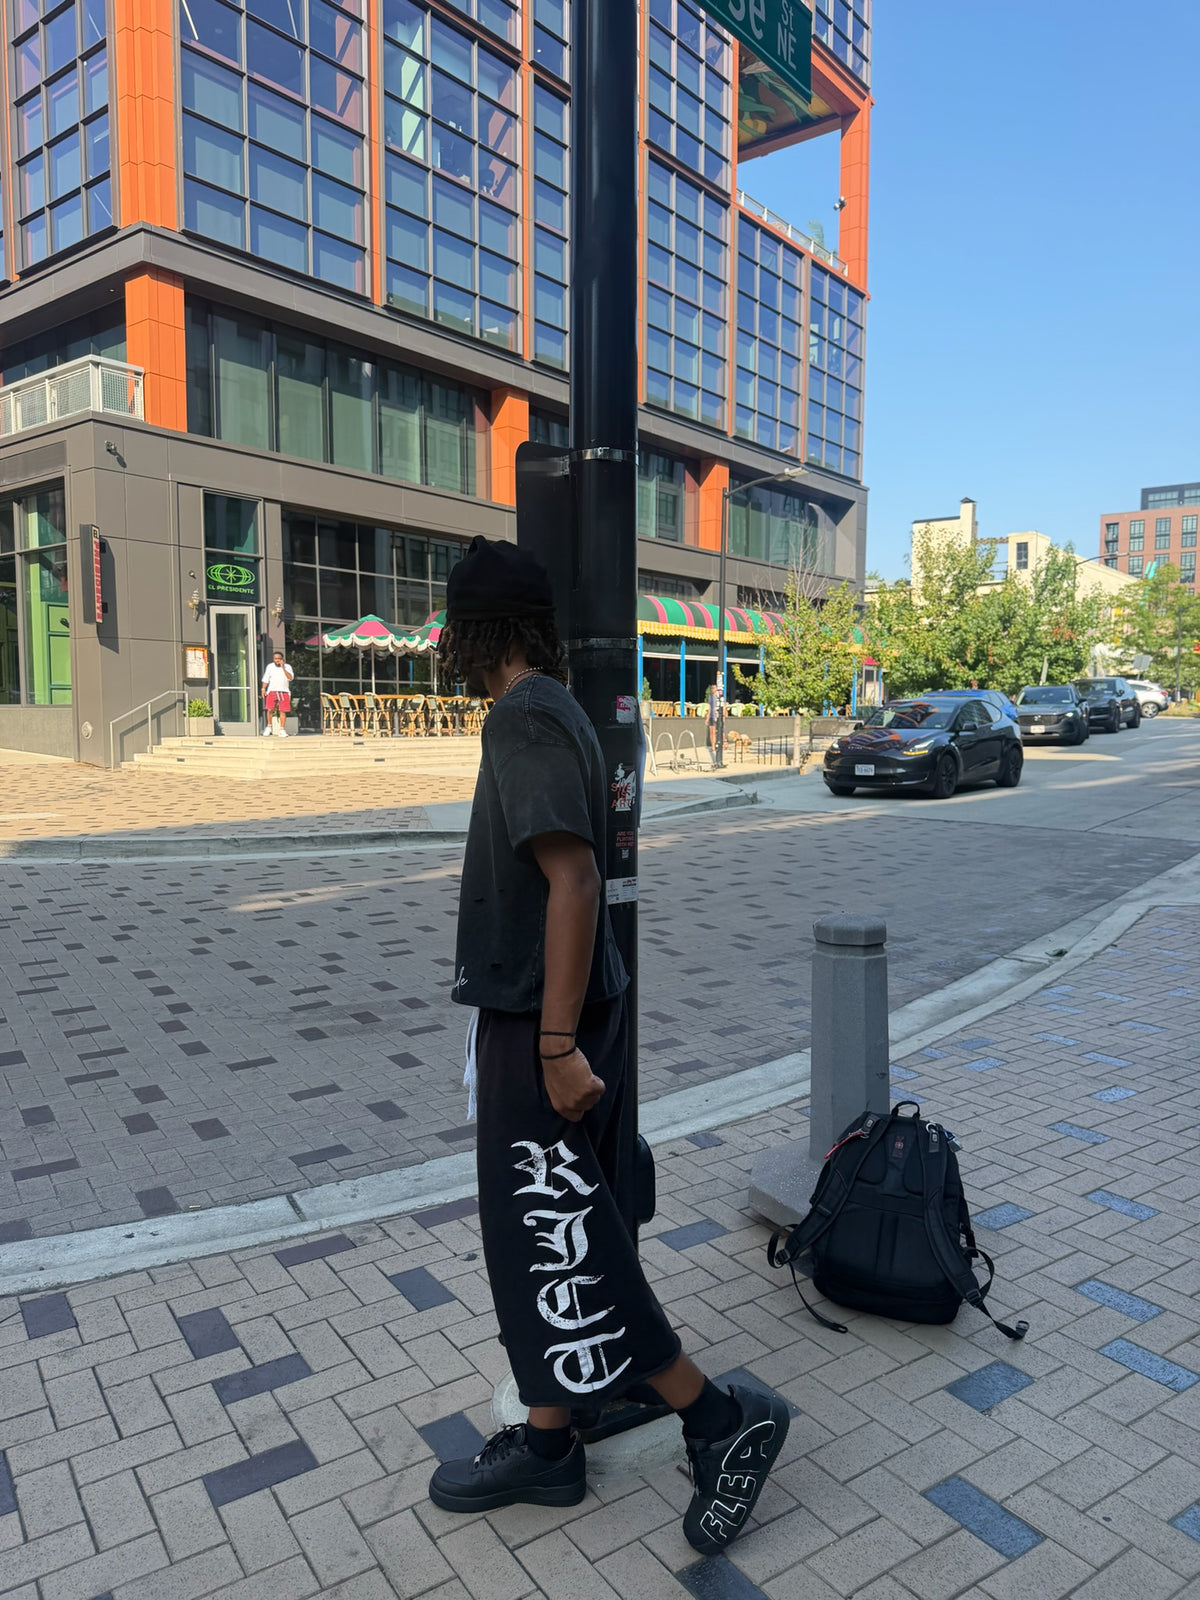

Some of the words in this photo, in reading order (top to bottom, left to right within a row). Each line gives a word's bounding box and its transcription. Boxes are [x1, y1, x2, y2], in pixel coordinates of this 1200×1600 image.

[781, 0, 794, 31] St
[777, 22, 797, 71] NE
[216, 585, 255, 595] PRESIDENTE
[611, 783, 631, 792] SHE
[617, 791, 627, 800] IS
[611, 799, 632, 809] ART
